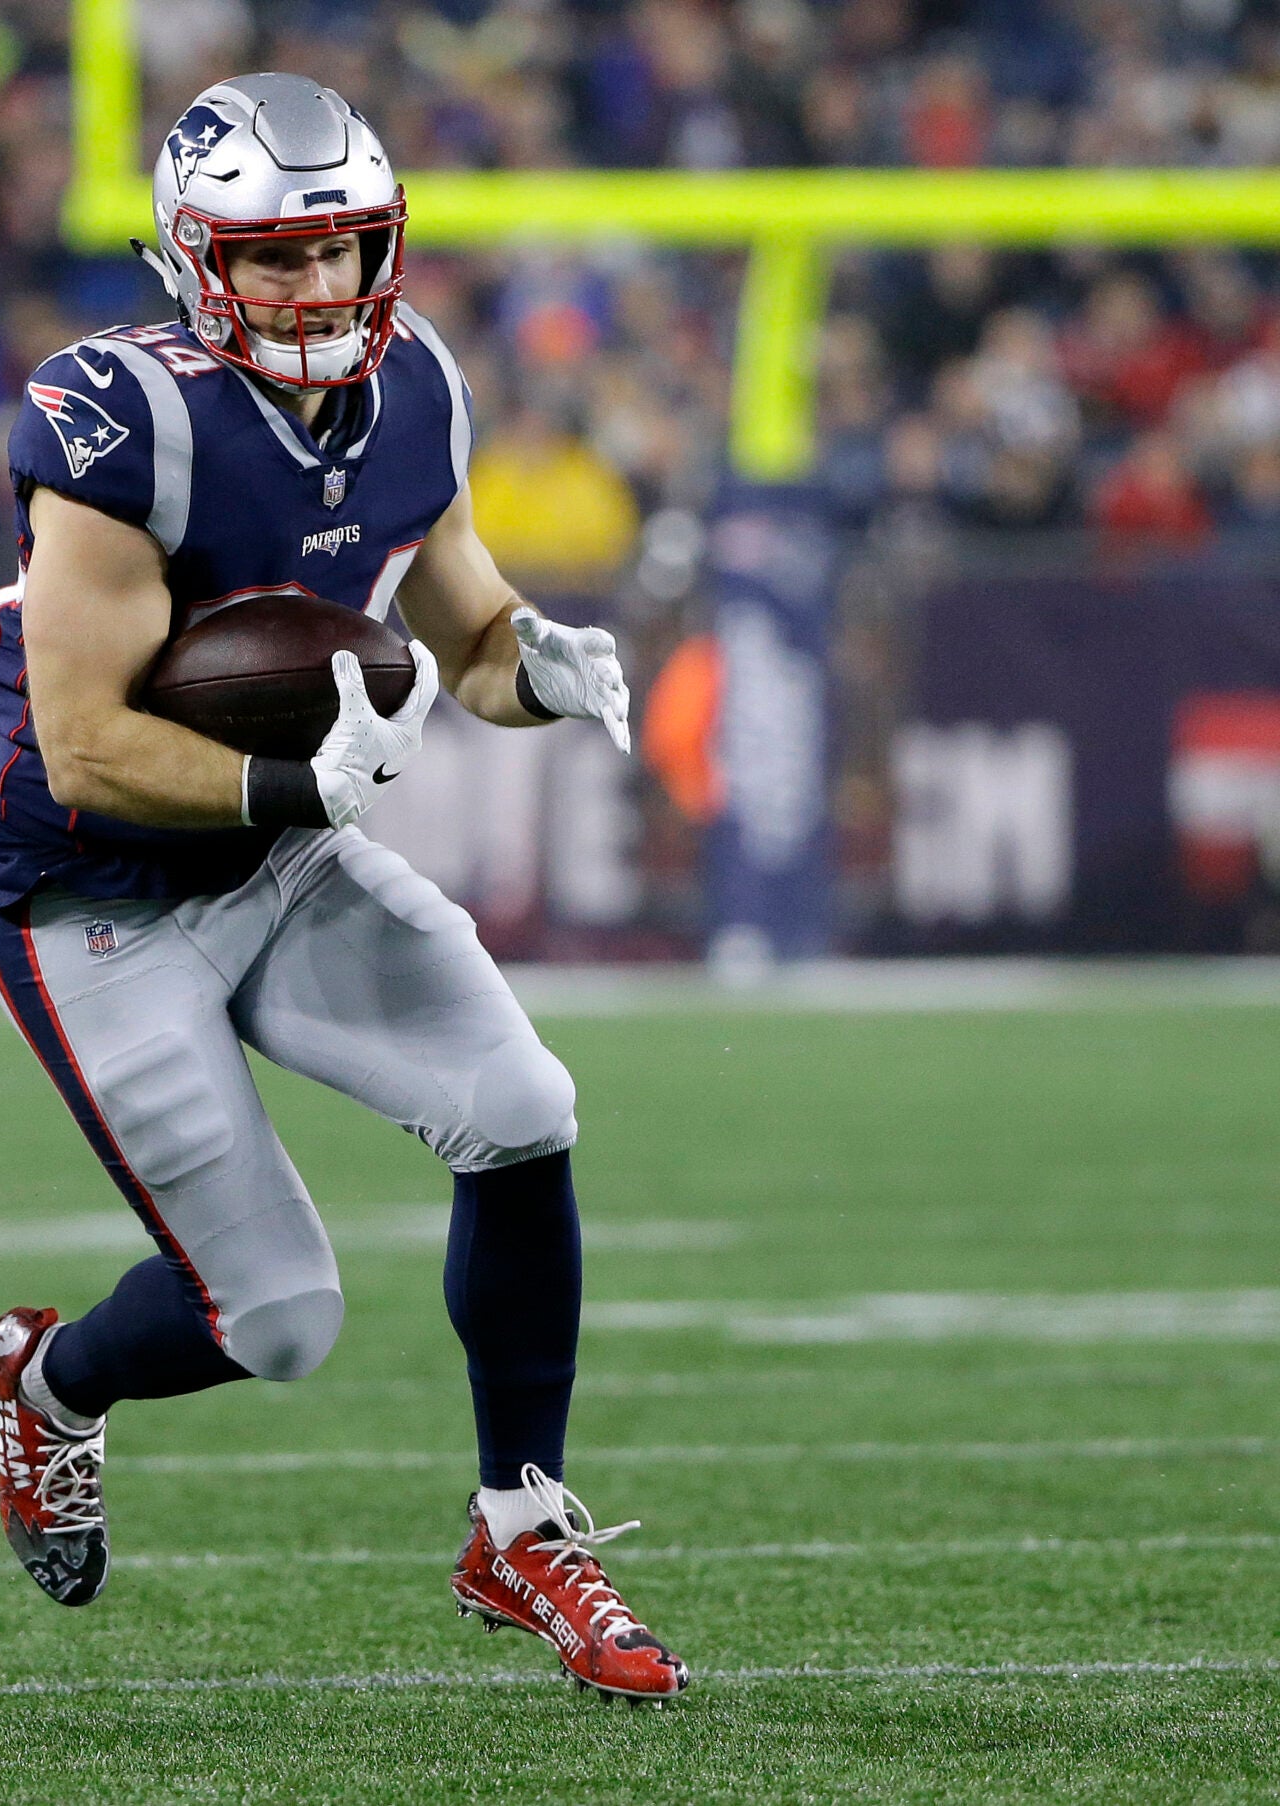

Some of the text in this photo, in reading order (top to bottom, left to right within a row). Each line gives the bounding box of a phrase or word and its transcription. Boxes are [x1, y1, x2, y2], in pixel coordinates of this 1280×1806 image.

[302, 525, 360, 557] PATRIOTS
[3, 1399, 34, 1489] TEAM
[490, 1554, 586, 1660] CAN'T BE BEAT
